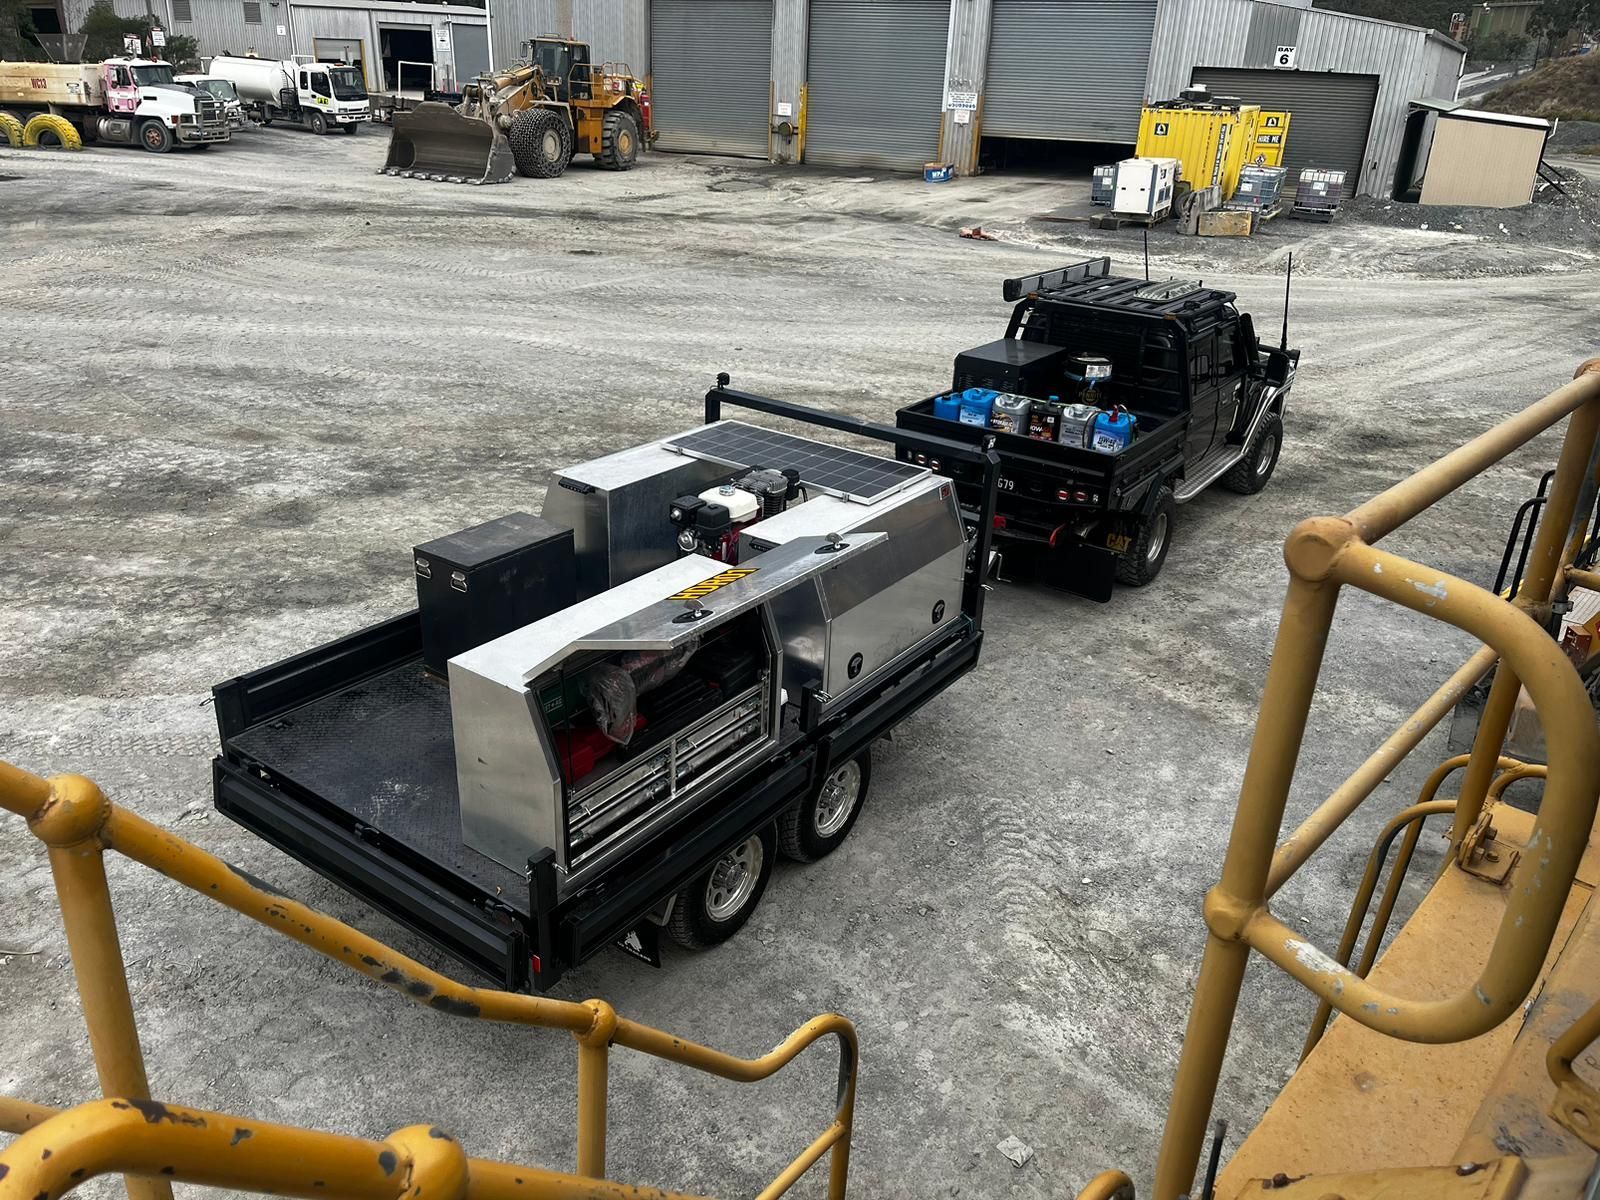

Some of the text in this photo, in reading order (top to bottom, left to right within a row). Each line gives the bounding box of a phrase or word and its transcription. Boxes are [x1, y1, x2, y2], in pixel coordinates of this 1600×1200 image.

[1280, 54, 1289, 65] 6
[31, 78, 47, 89] WC13
[1257, 135, 1279, 144] HIRE ME
[1106, 532, 1132, 553] CAT
